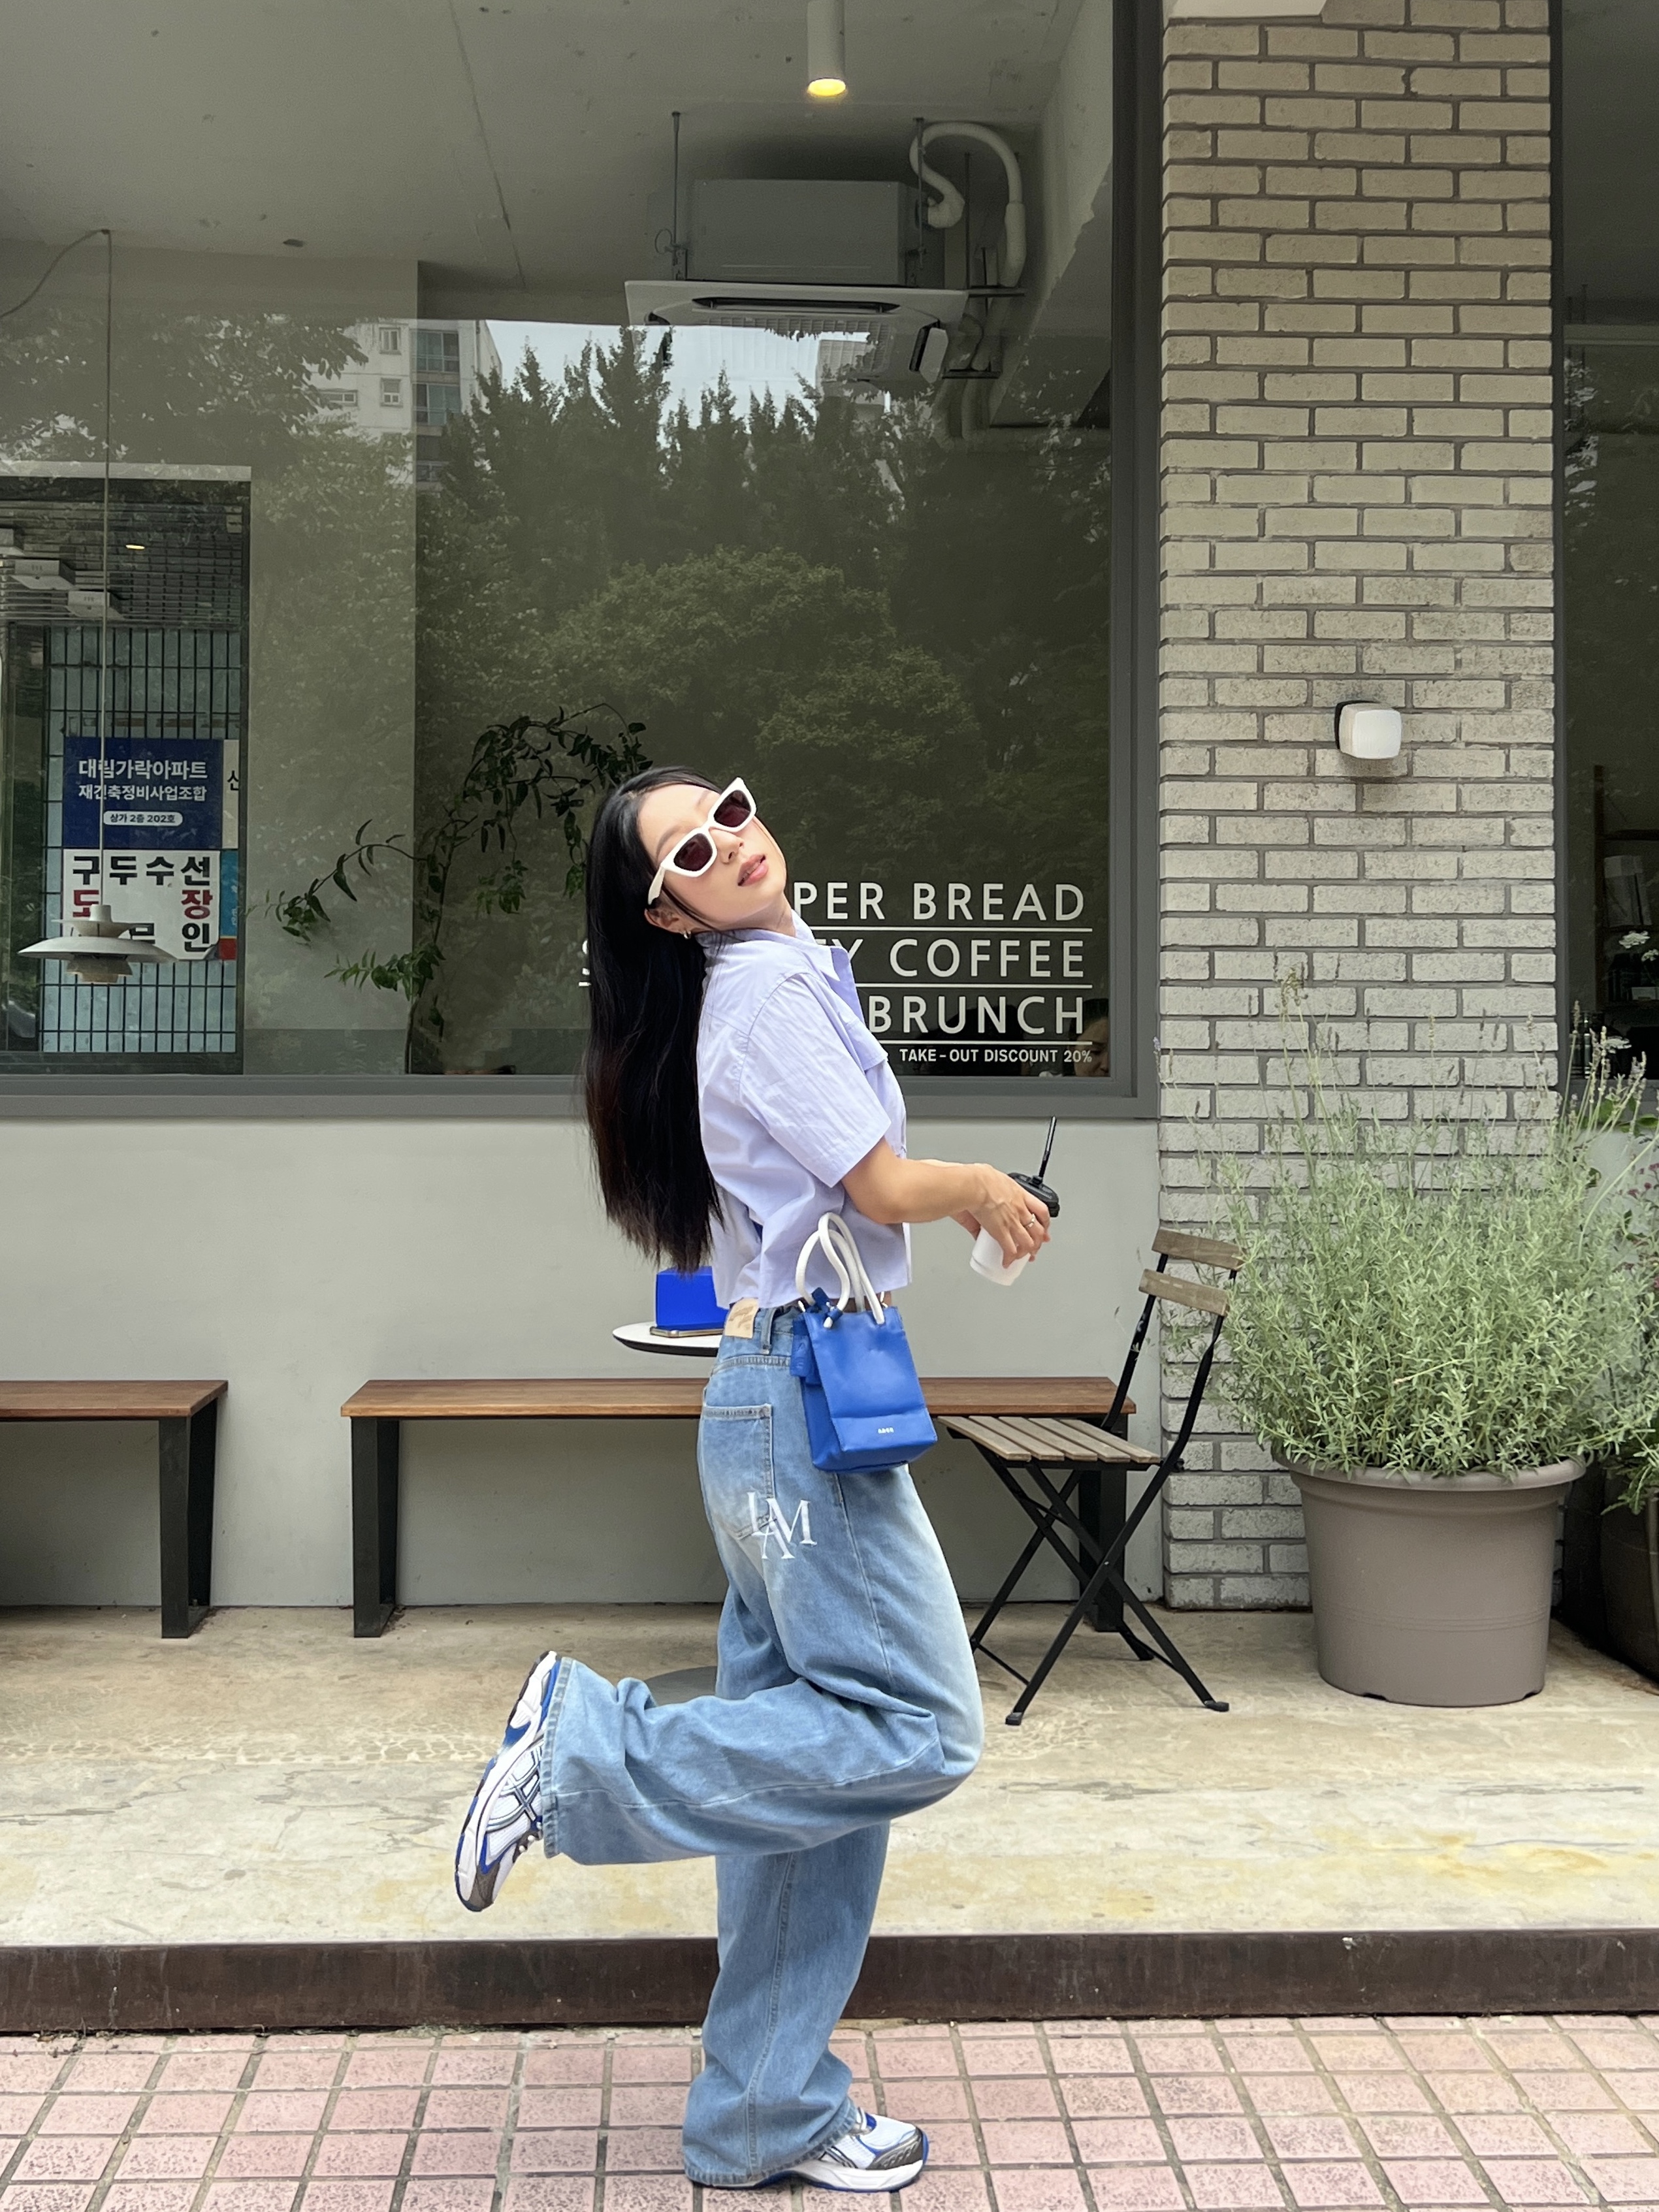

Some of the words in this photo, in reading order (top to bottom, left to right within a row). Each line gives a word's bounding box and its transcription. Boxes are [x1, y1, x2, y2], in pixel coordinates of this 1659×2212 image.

[78, 759, 208, 780] 대림가락아파트
[78, 784, 208, 802] 재건축정비사업조합
[110, 813, 127, 823] 상가
[147, 814, 176, 823] 202호
[72, 856, 210, 886] 구두수선
[913, 882, 1084, 922] BREAD
[889, 938, 1084, 978] COFFEE
[868, 995, 1083, 1034] BRUNCH
[984, 1048, 1058, 1063] DISCOUNT
[1063, 1050, 1093, 1063] 20%
